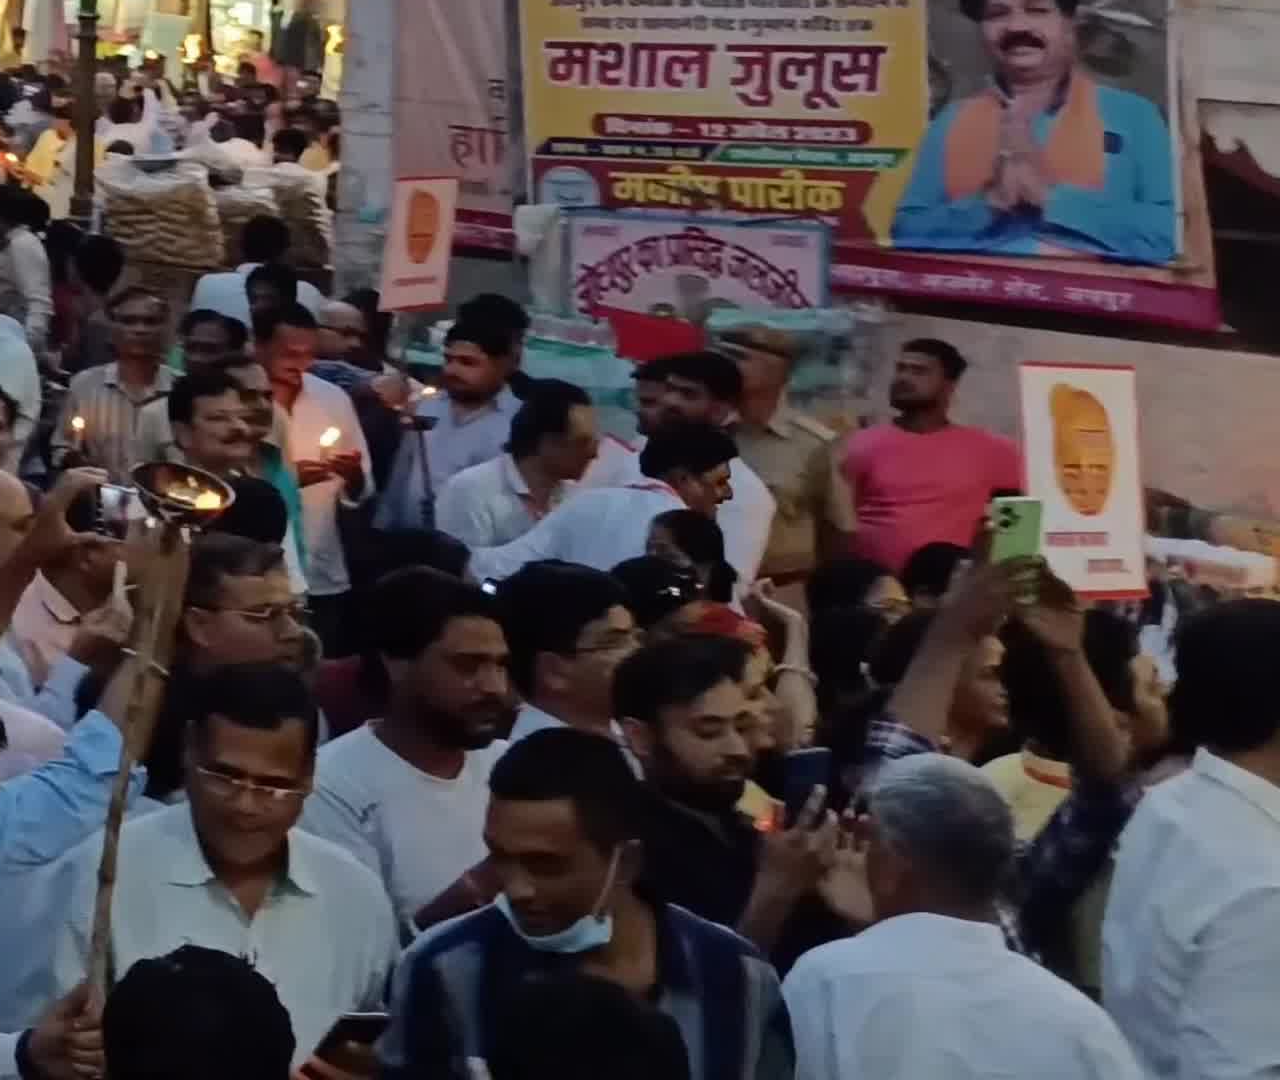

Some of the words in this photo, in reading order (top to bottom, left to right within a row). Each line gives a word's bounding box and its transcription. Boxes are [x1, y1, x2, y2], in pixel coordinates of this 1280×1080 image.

[544, 41, 717, 89] मशाल
[724, 44, 887, 110] जुलूस
[727, 169, 847, 212] पारीक
